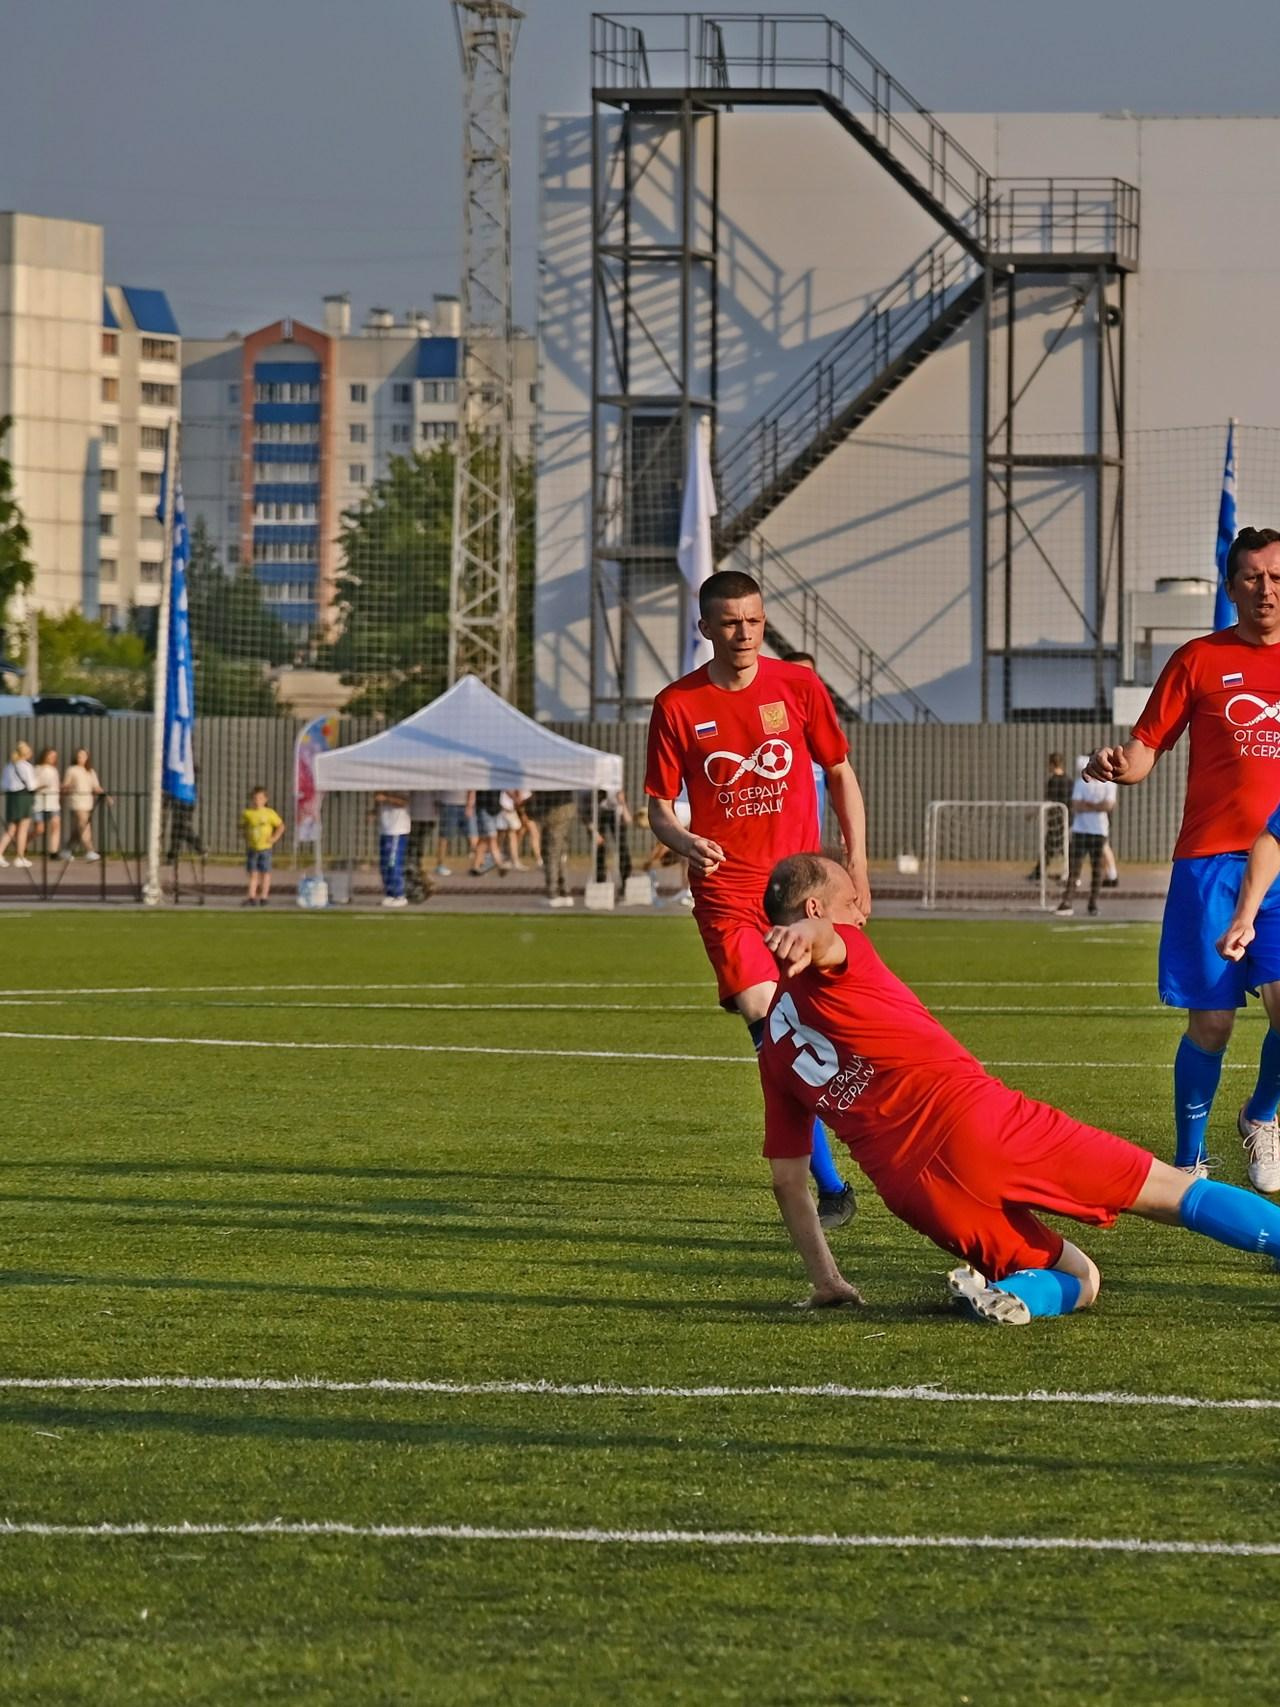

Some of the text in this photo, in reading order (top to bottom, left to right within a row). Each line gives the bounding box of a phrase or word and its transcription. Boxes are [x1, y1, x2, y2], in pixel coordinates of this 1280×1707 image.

[1234, 730, 1253, 742] ОТ
[1240, 744, 1248, 756] К
[718, 781, 788, 803] ОТ СЕРДЦА
[725, 807, 734, 819] К
[769, 991, 839, 1088] 3
